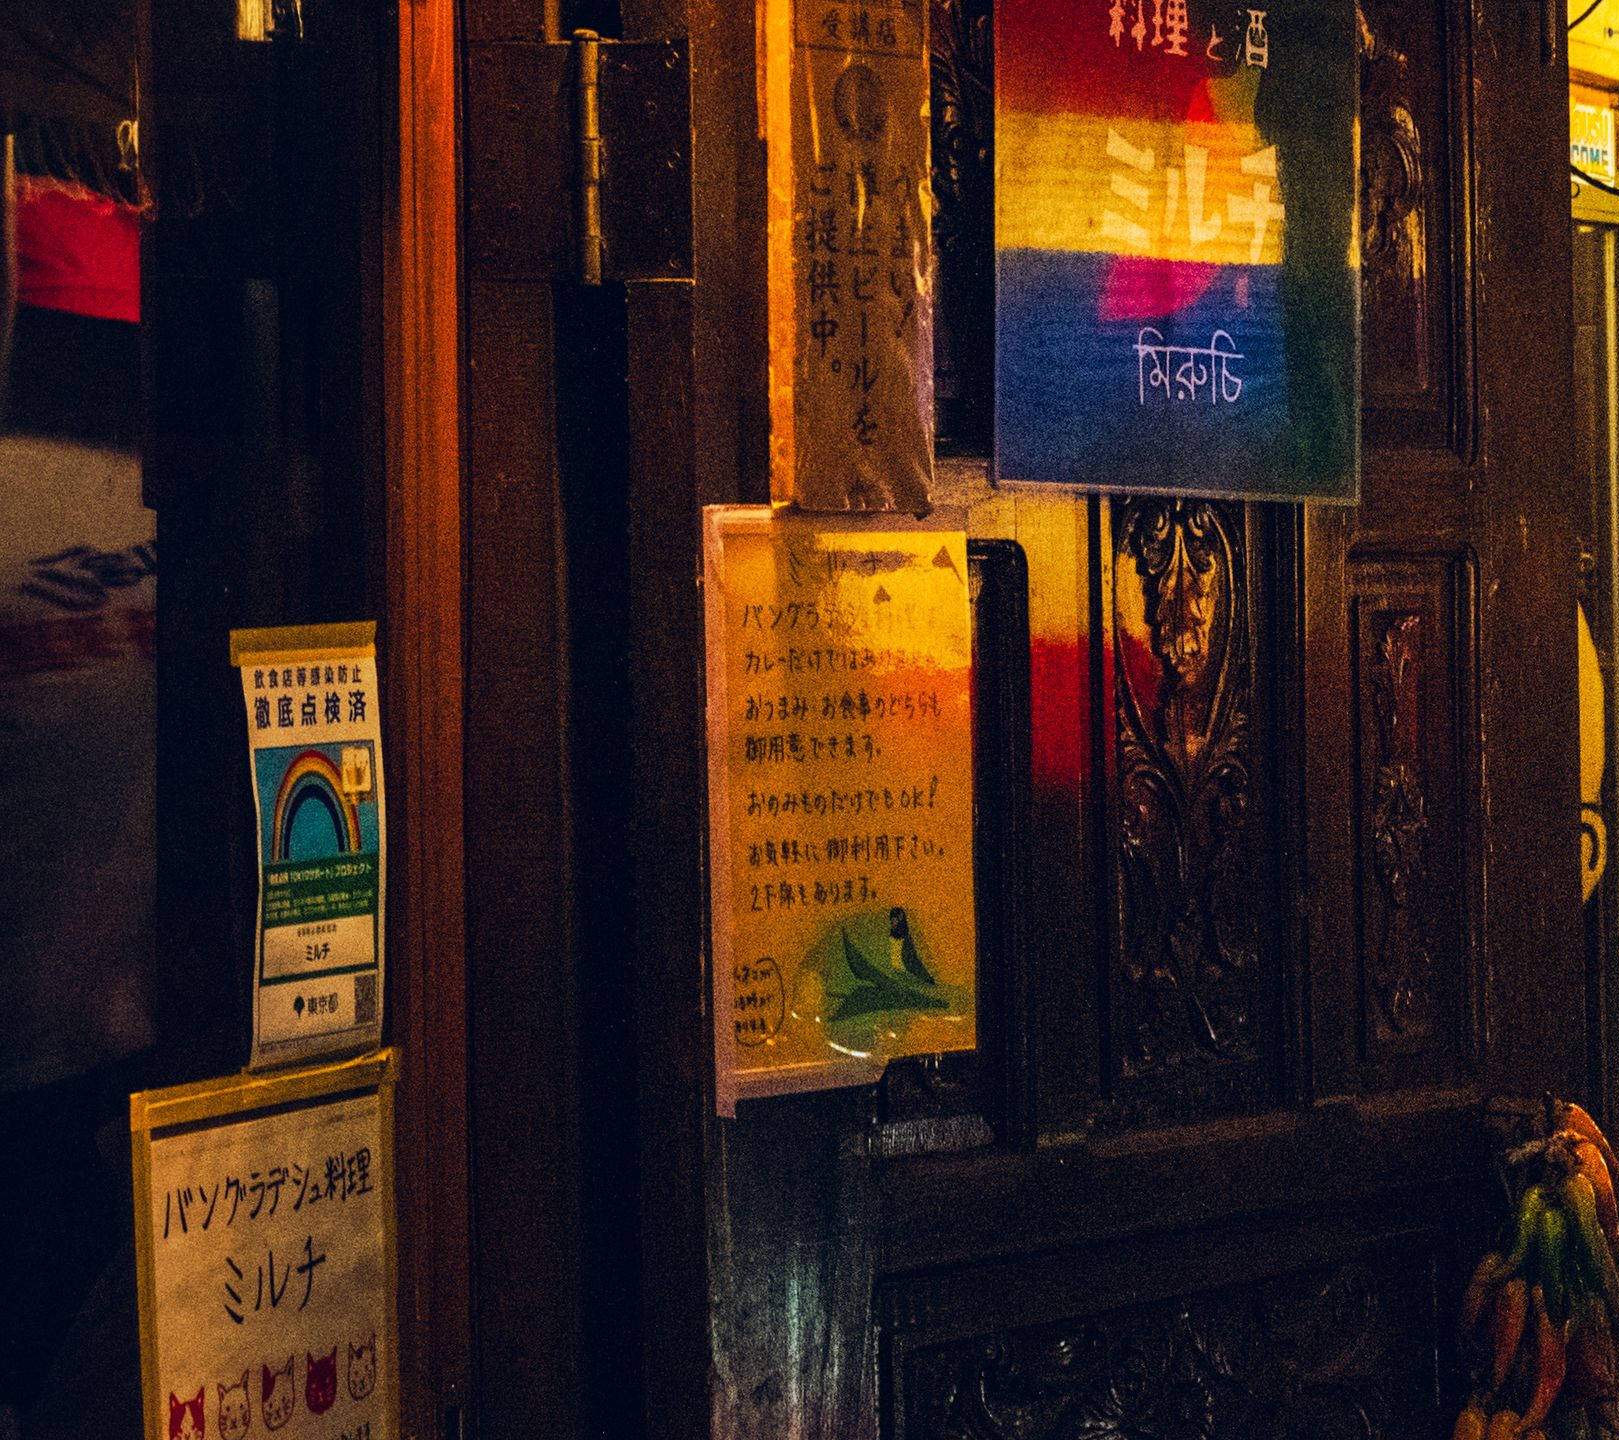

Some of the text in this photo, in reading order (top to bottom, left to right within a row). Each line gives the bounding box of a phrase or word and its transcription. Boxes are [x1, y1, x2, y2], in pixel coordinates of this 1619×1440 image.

[1099, 126, 1286, 310] ミルチ
[254, 692, 368, 731] 徹底点検済
[304, 941, 331, 963] ミルチ
[307, 993, 339, 1016] 東京都
[162, 1146, 374, 1240] バングラデシュ料理
[223, 1234, 326, 1325] ミルチ
